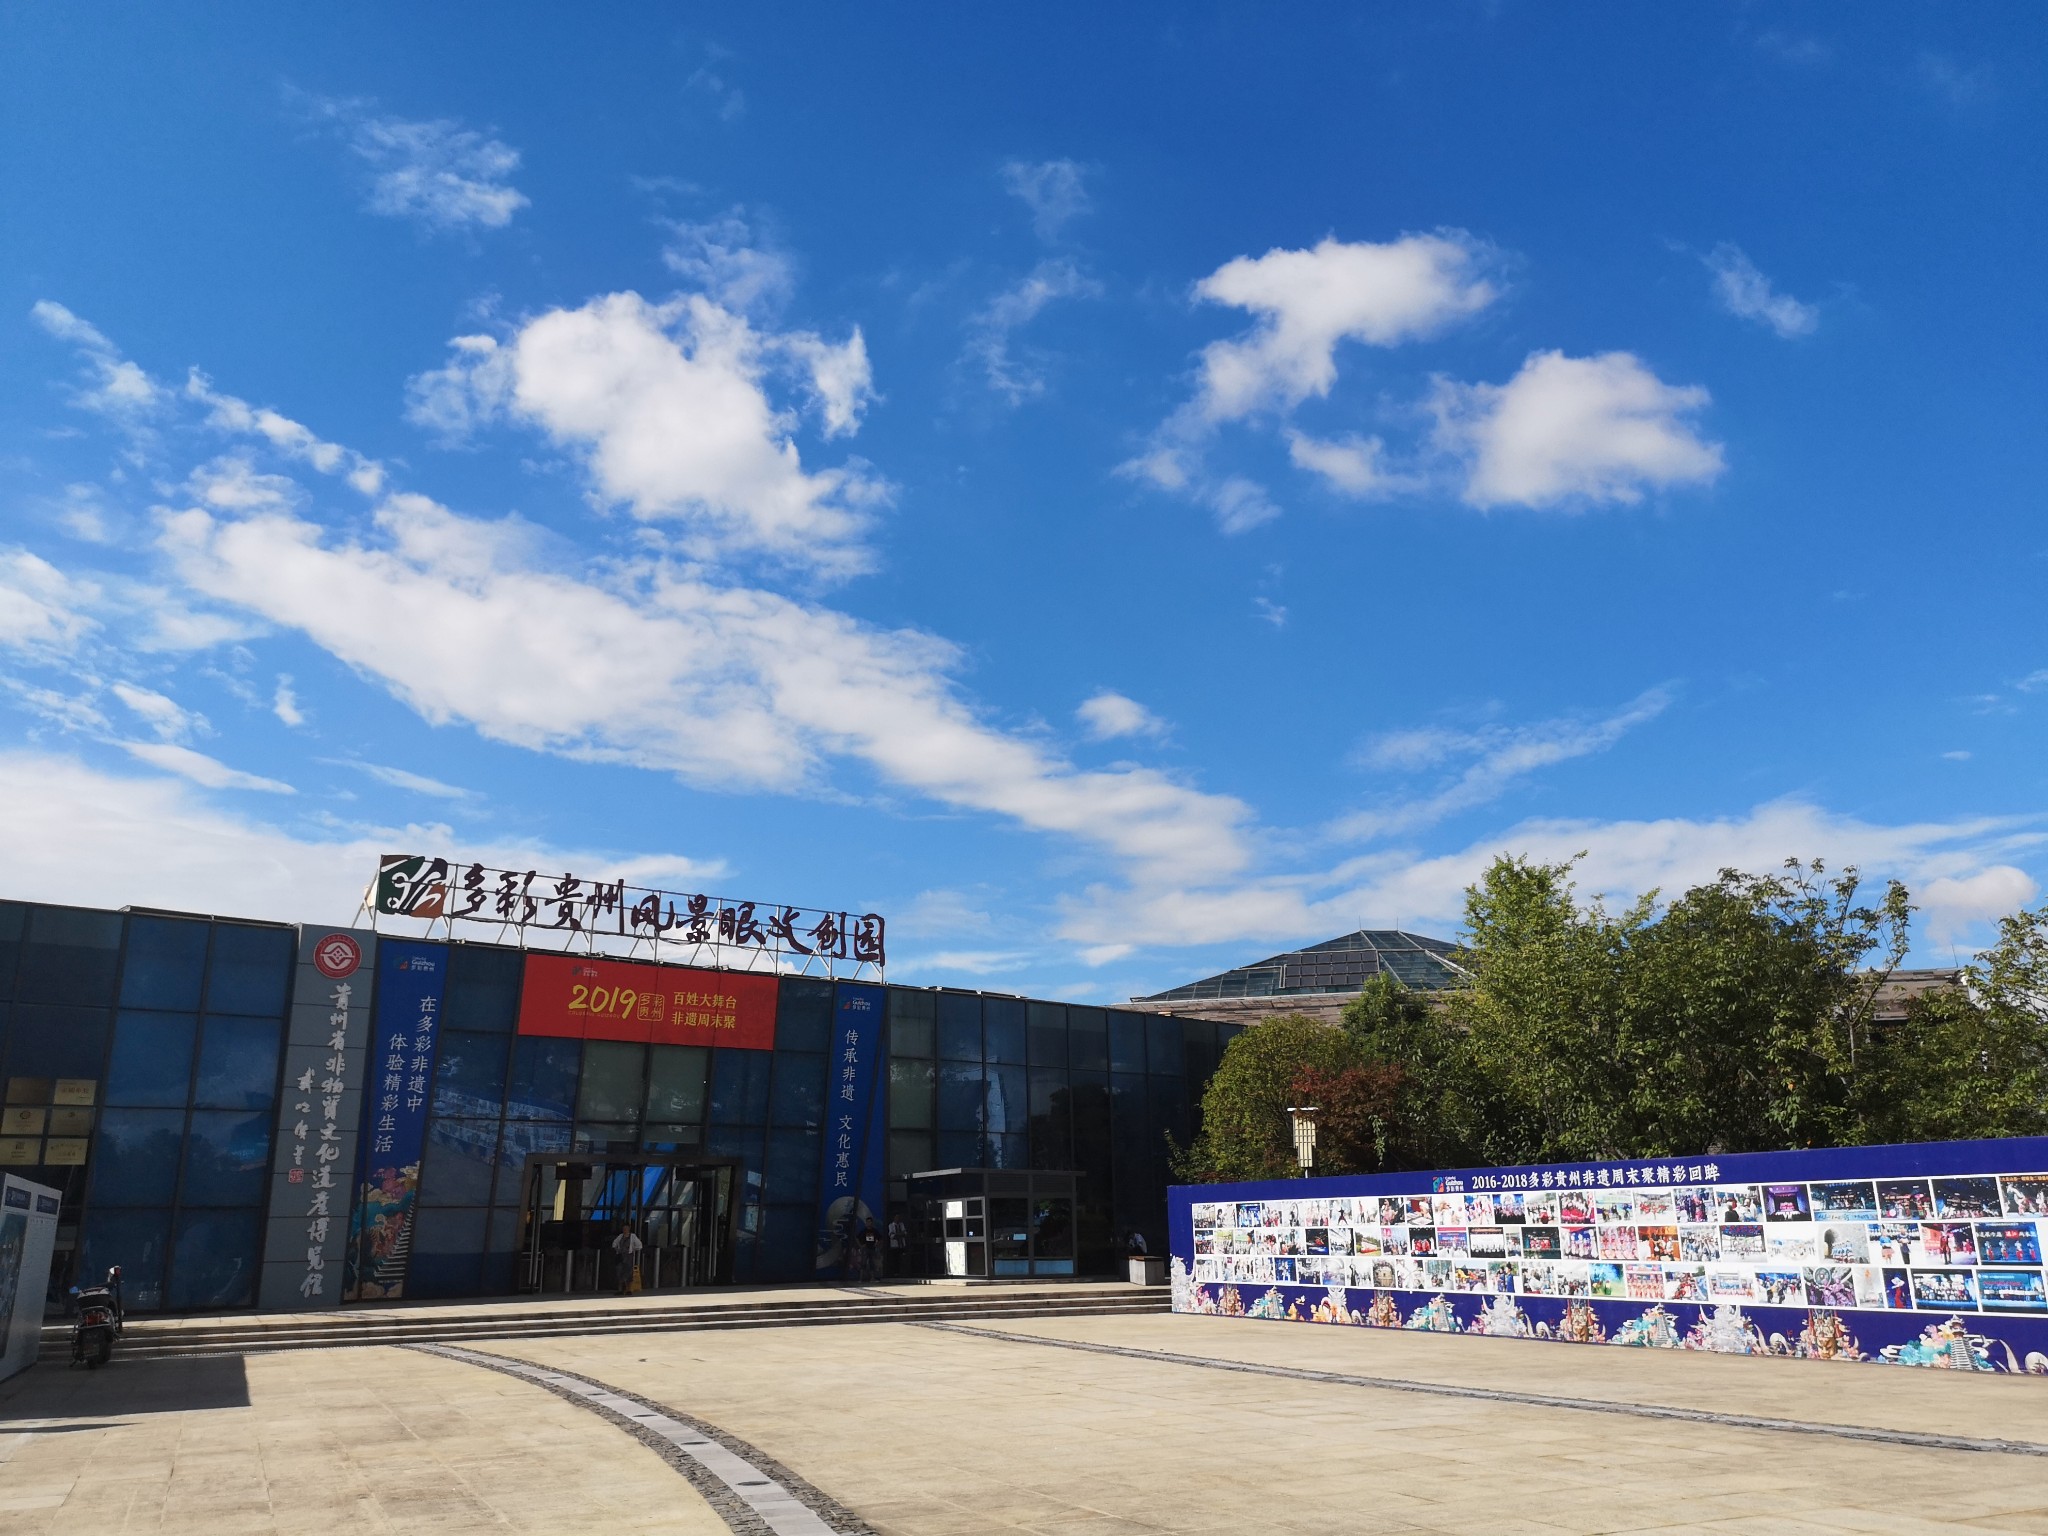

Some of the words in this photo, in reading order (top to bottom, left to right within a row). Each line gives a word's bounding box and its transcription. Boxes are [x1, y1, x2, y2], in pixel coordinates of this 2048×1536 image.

[568, 984, 637, 1019] 2019
[671, 1011, 736, 1029] 非遗周末聚
[673, 991, 737, 1009] 百姓大舞台
[407, 995, 437, 1113] 在多彩非遗中
[840, 1029, 859, 1101] 传承非遗
[374, 1033, 408, 1153] 体验精彩生活
[834, 1114, 852, 1187] 文化惠民
[1472, 1164, 1720, 1190] 2016-2018多彩贵州非遗周末聚精彩回眸
